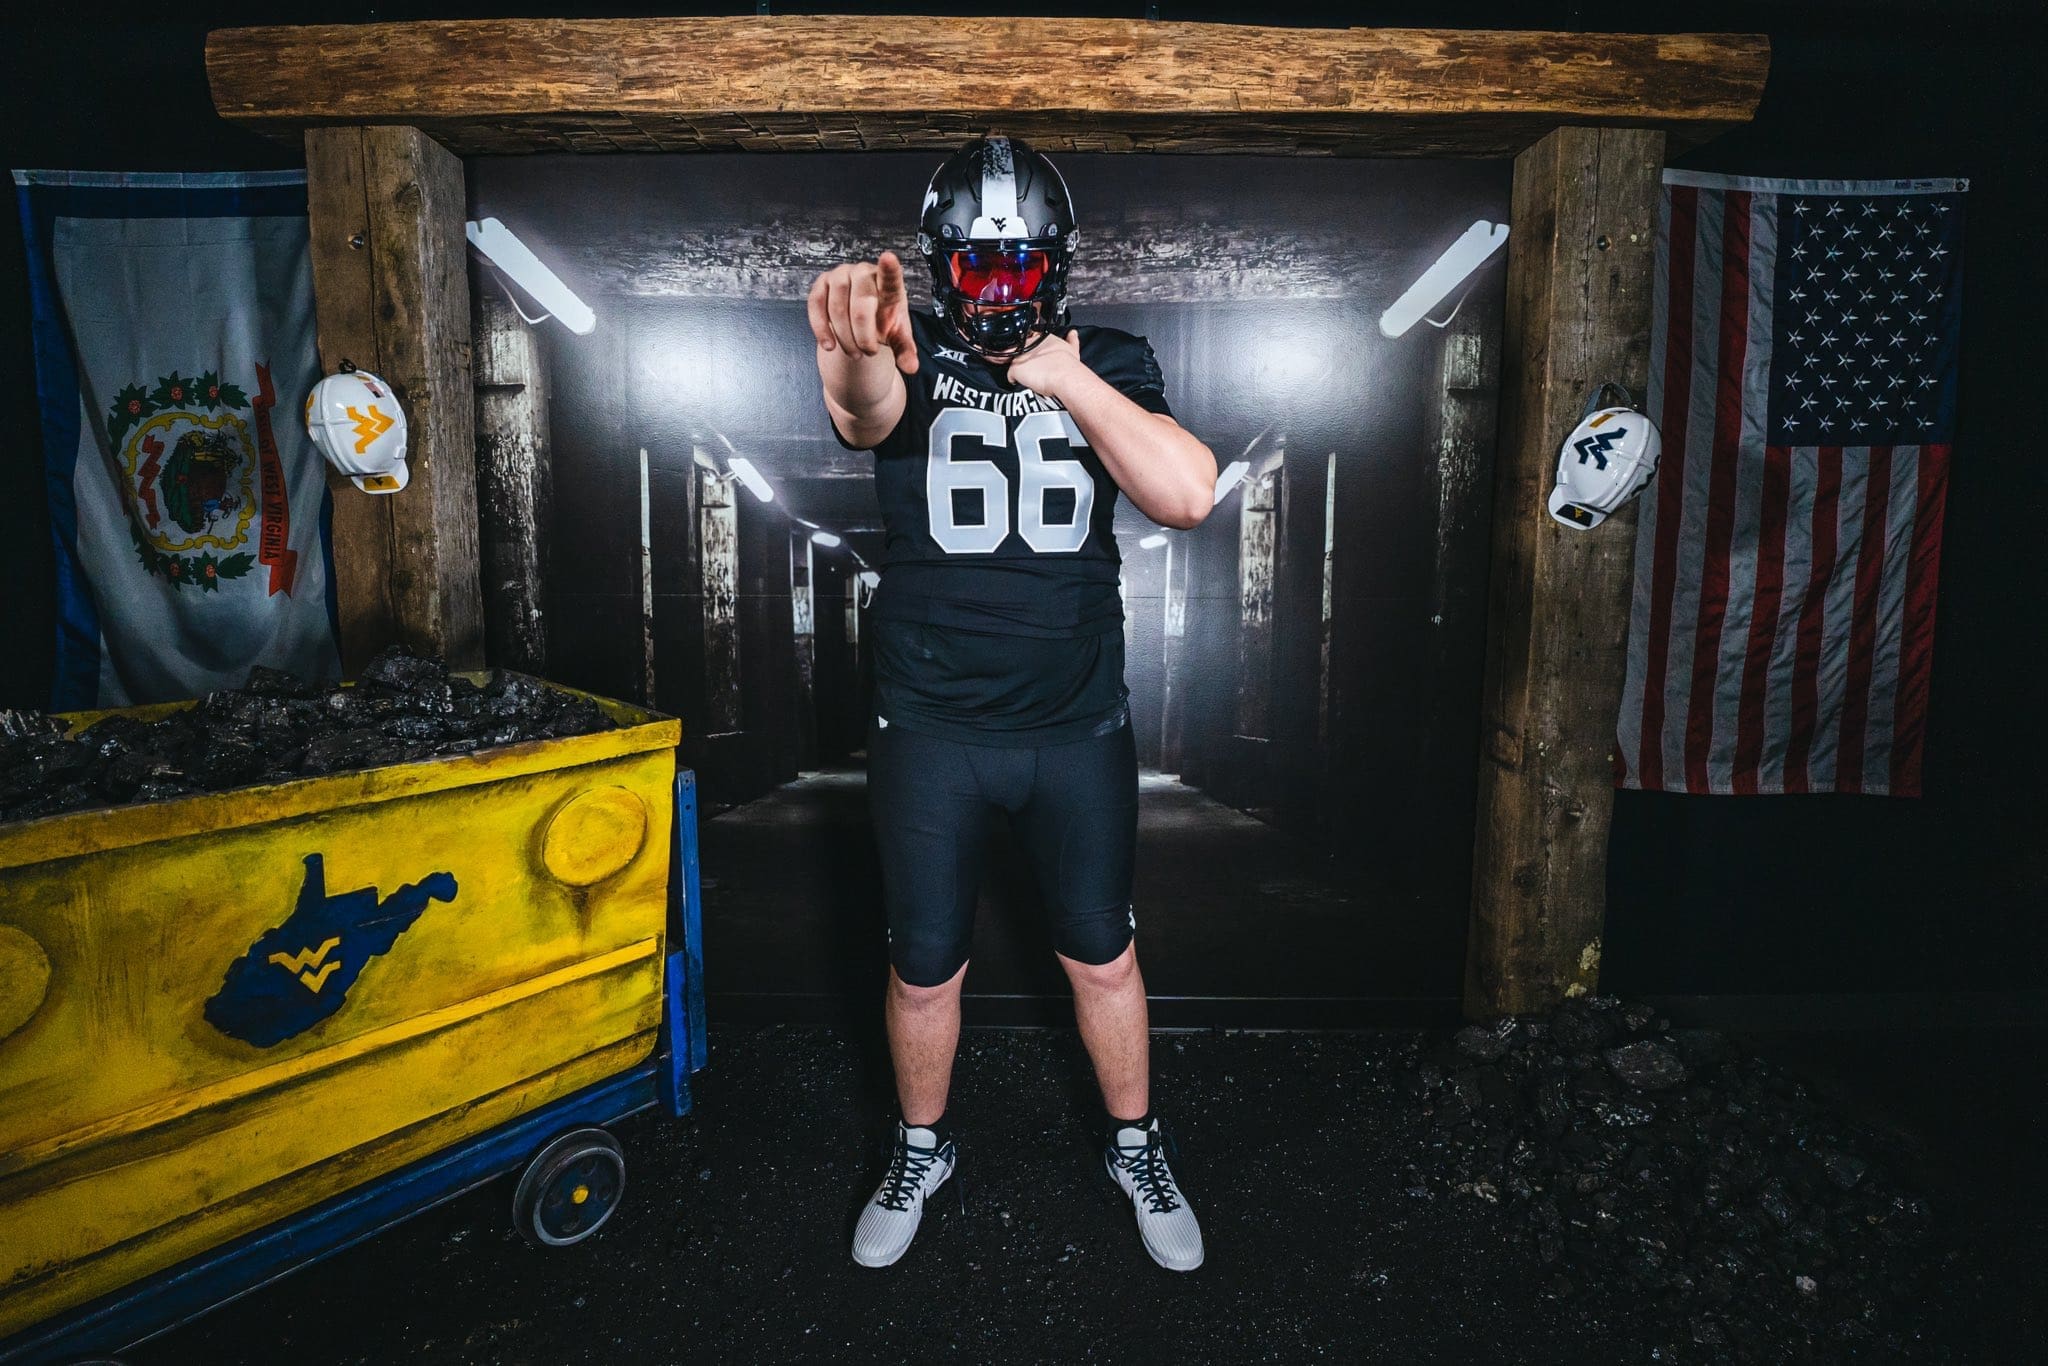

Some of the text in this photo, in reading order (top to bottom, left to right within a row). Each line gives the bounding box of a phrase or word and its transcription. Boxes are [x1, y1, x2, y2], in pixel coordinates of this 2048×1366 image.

[932, 373, 993, 410] WEST
[262, 460, 281, 497] WEST
[926, 407, 1094, 554] 66
[264, 501, 283, 560] VIRGINIA
